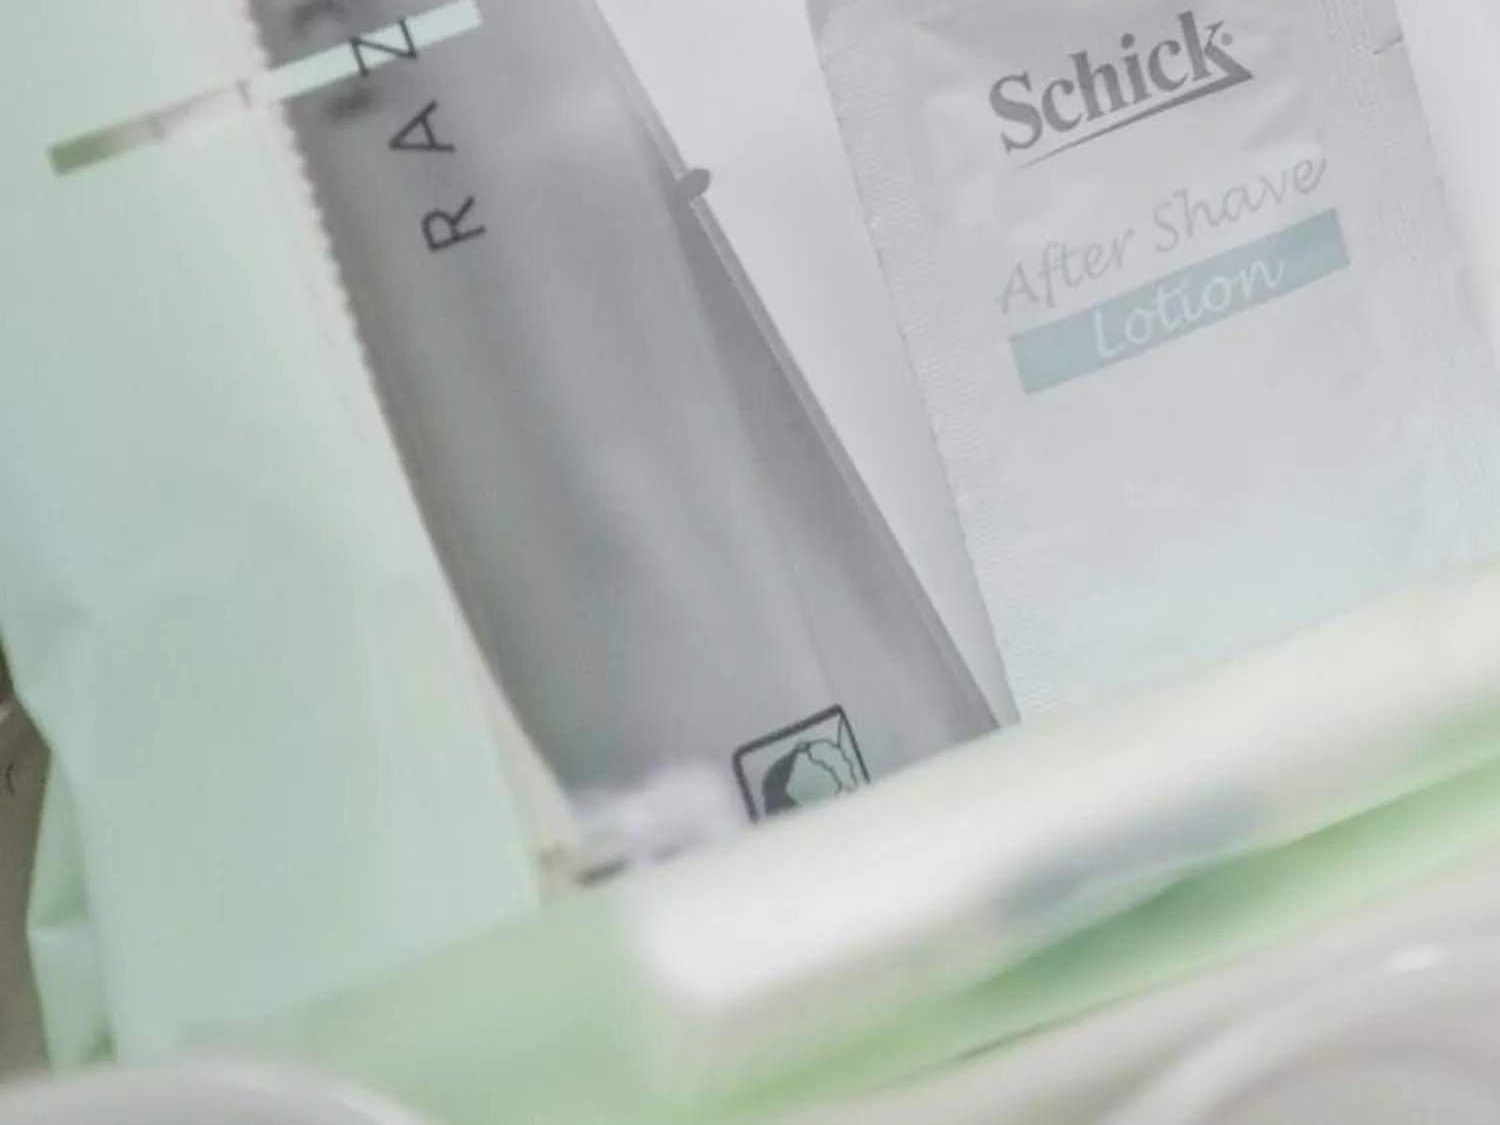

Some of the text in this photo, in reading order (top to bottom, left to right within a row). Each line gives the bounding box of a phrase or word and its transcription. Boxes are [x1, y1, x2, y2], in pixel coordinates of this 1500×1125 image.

[988, 9, 1255, 155] Schick
[995, 153, 1328, 314] After Shave
[1092, 256, 1289, 359] Lotion
